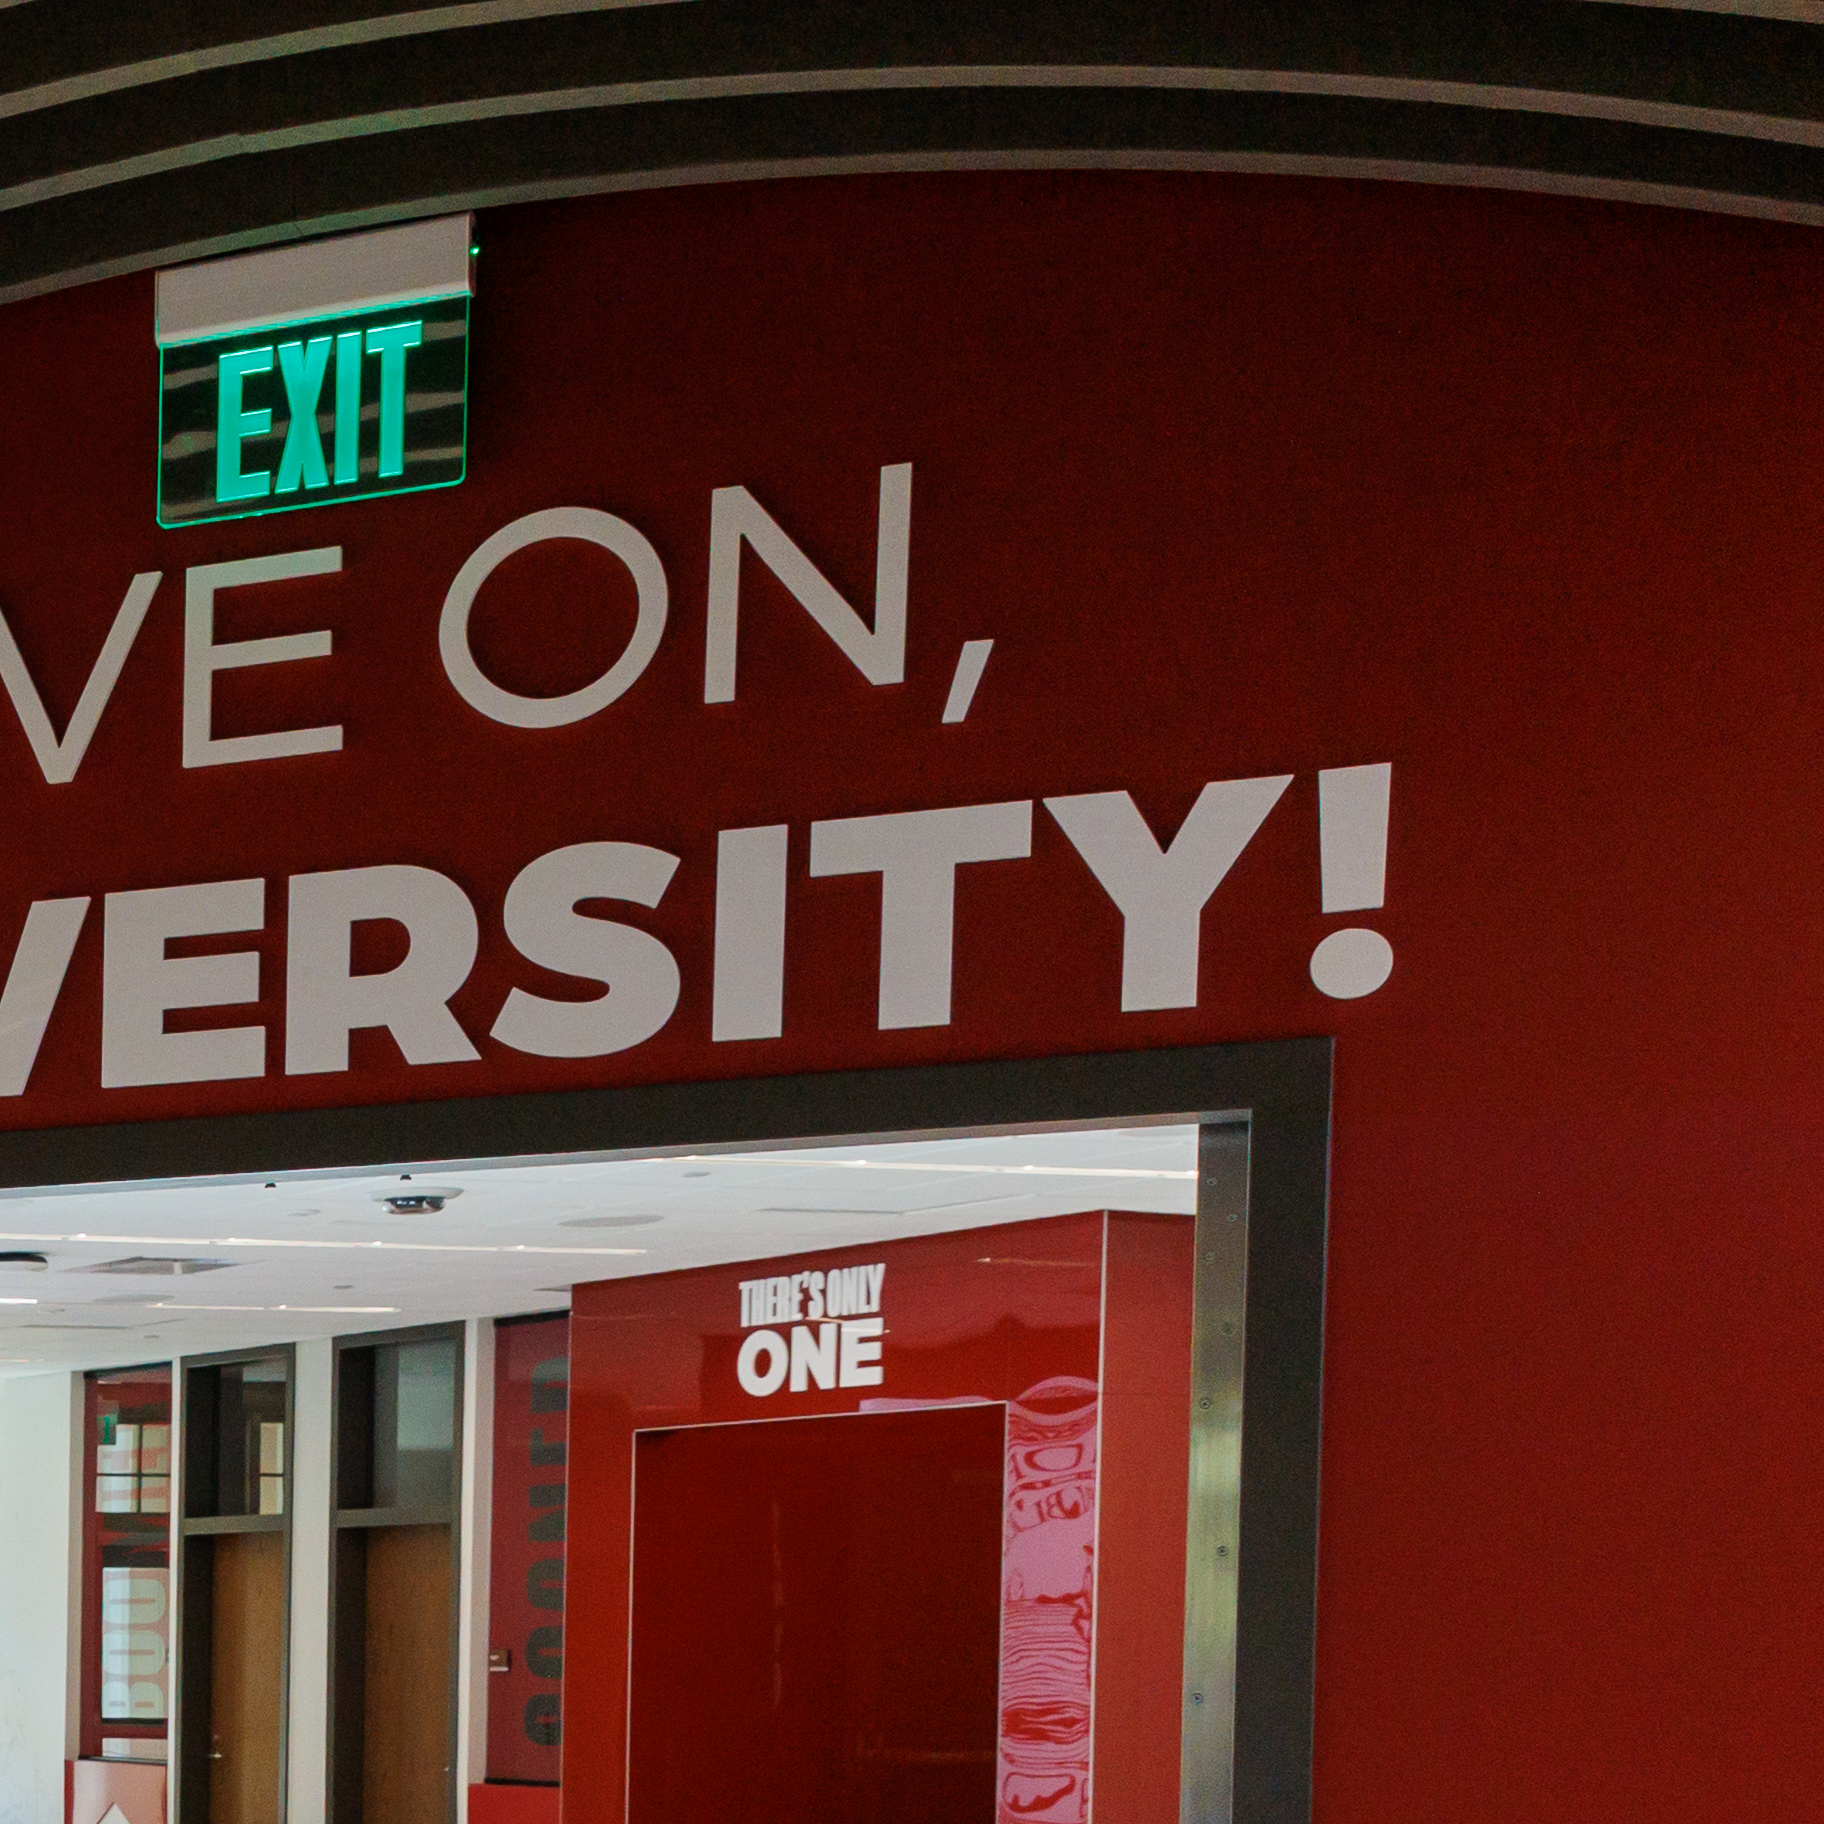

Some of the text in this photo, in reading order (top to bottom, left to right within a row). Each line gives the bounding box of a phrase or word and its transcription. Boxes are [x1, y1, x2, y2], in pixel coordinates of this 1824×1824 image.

[215, 319, 424, 503] EXIT
[437, 462, 996, 728] ON,
[736, 1317, 885, 1398] ONE
[738, 1262, 887, 1328] THERE'S ONLY
